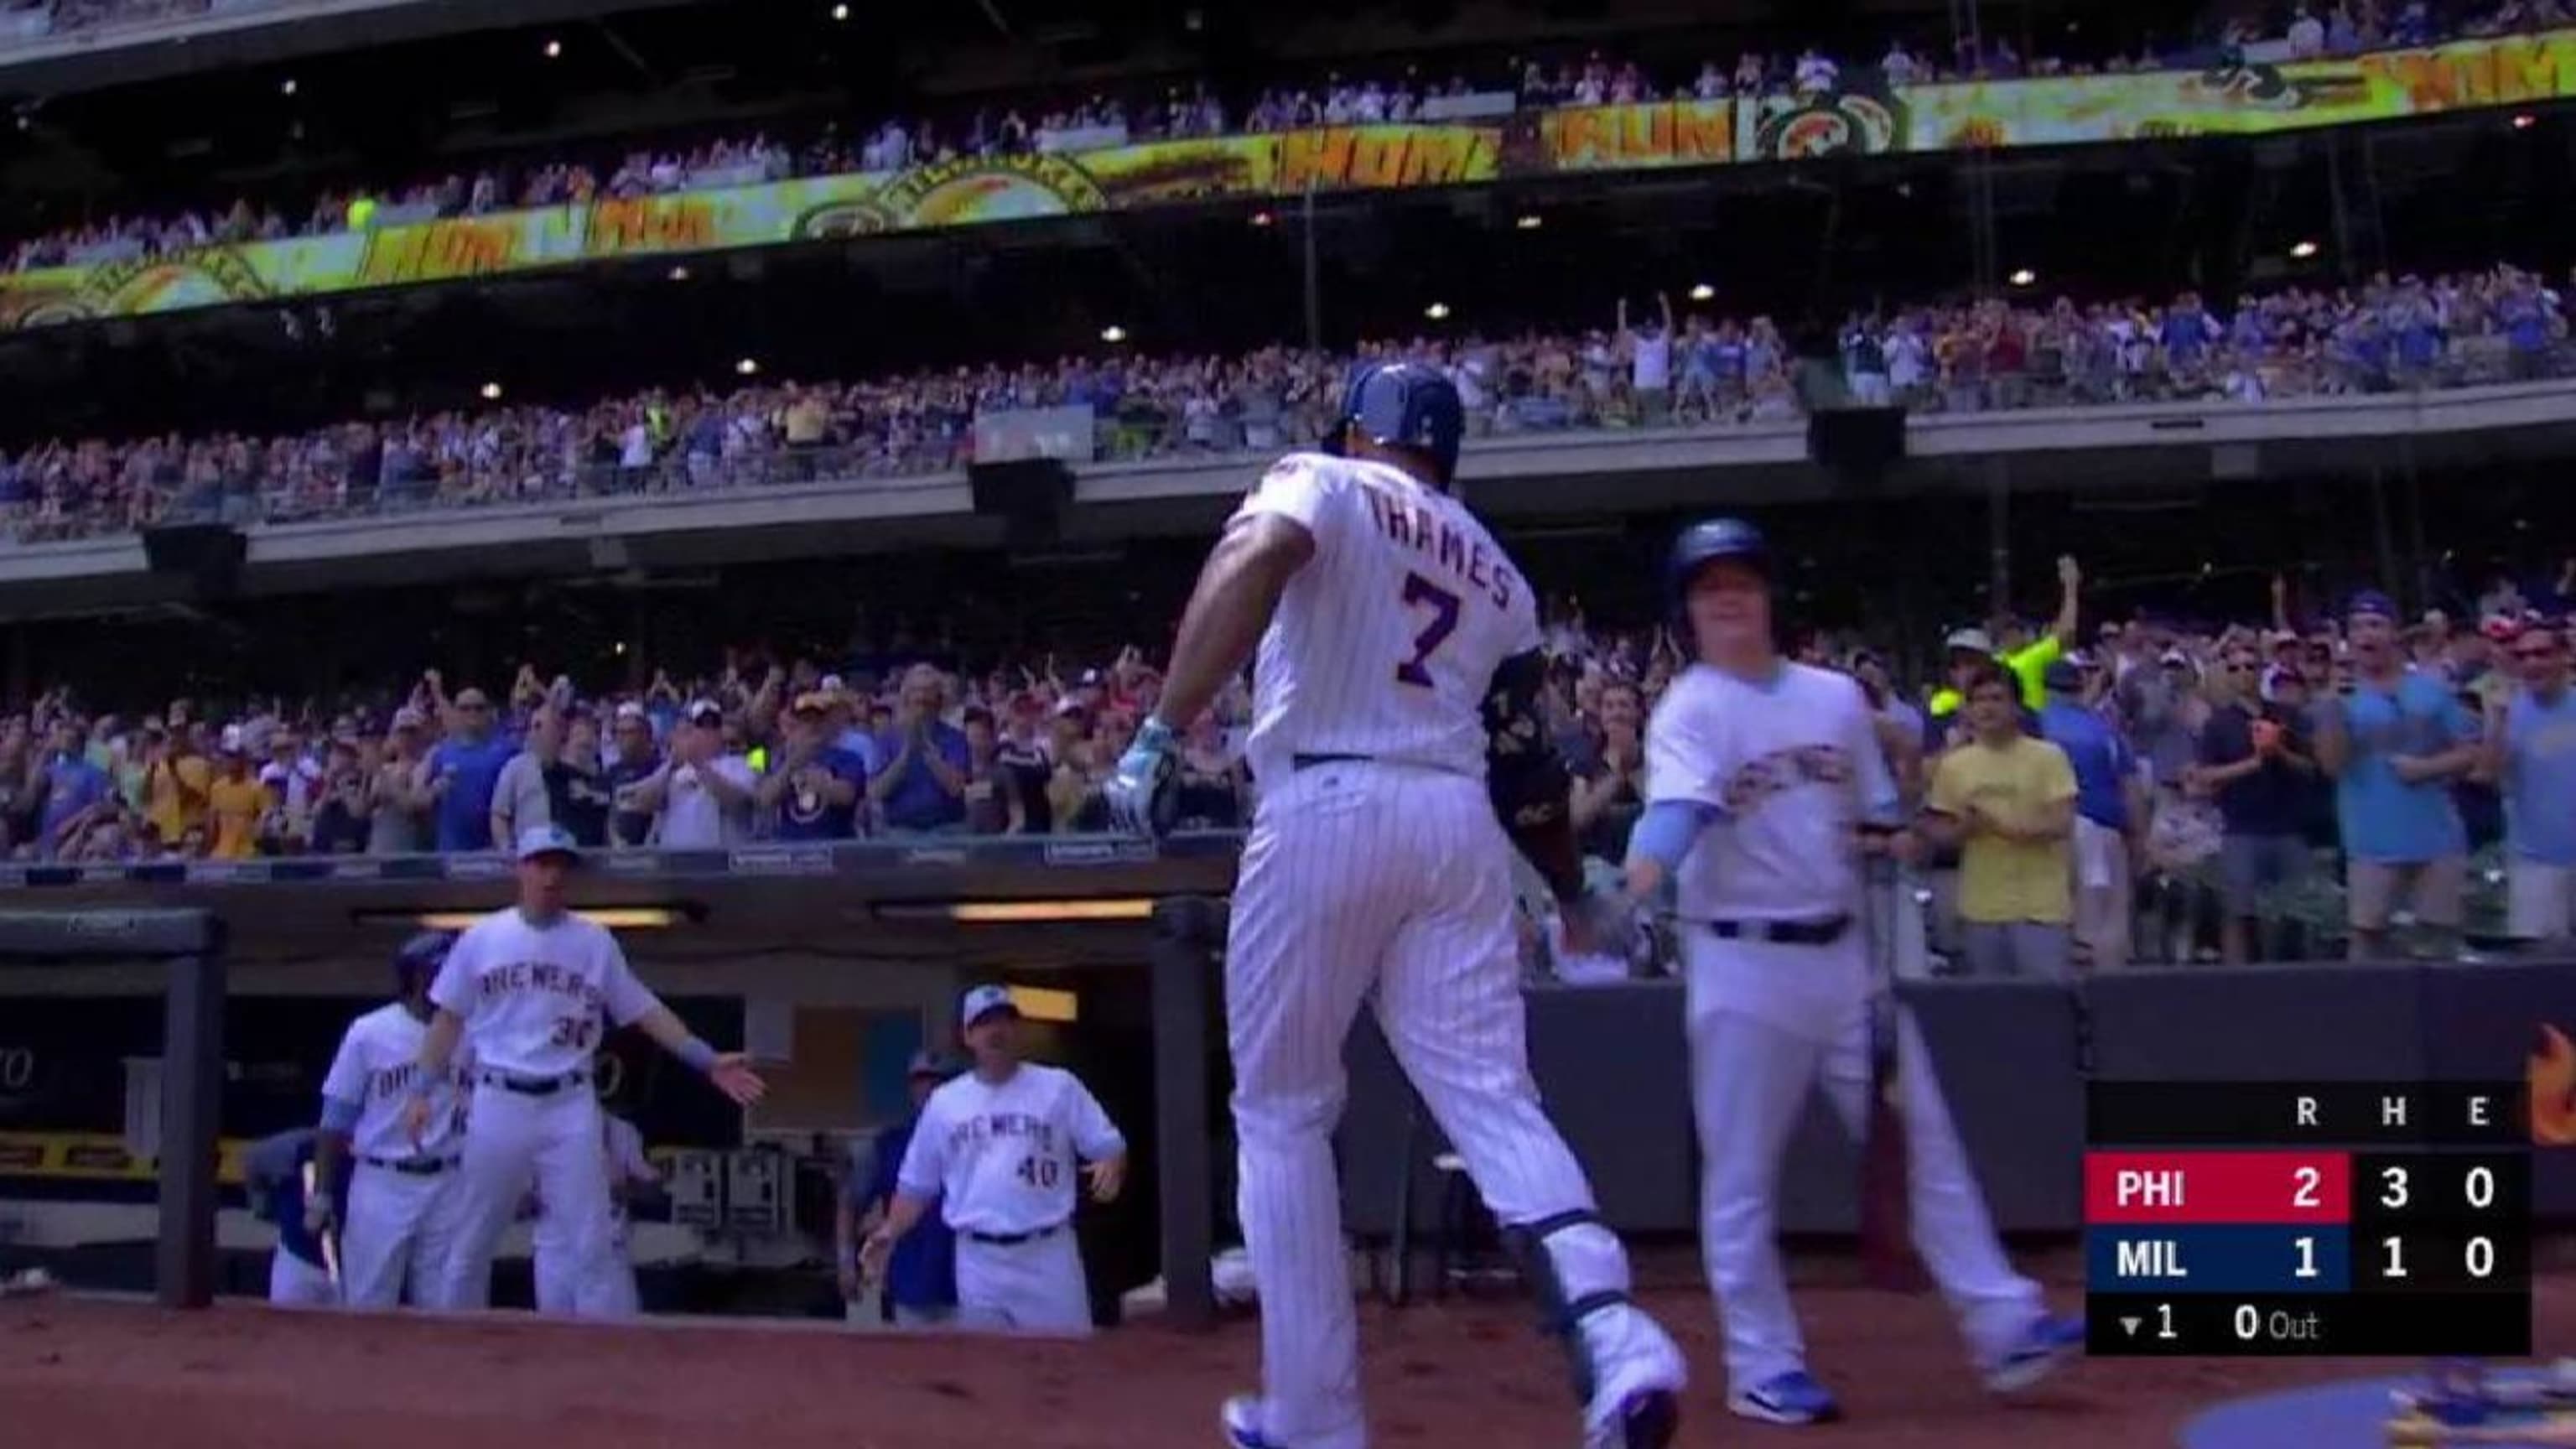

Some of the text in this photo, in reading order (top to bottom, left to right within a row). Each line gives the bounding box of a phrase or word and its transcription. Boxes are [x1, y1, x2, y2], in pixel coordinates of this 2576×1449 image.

[1362, 483, 1515, 610] THAMES
[1396, 570, 1461, 688] 7
[1016, 1156, 1058, 1188] 40
